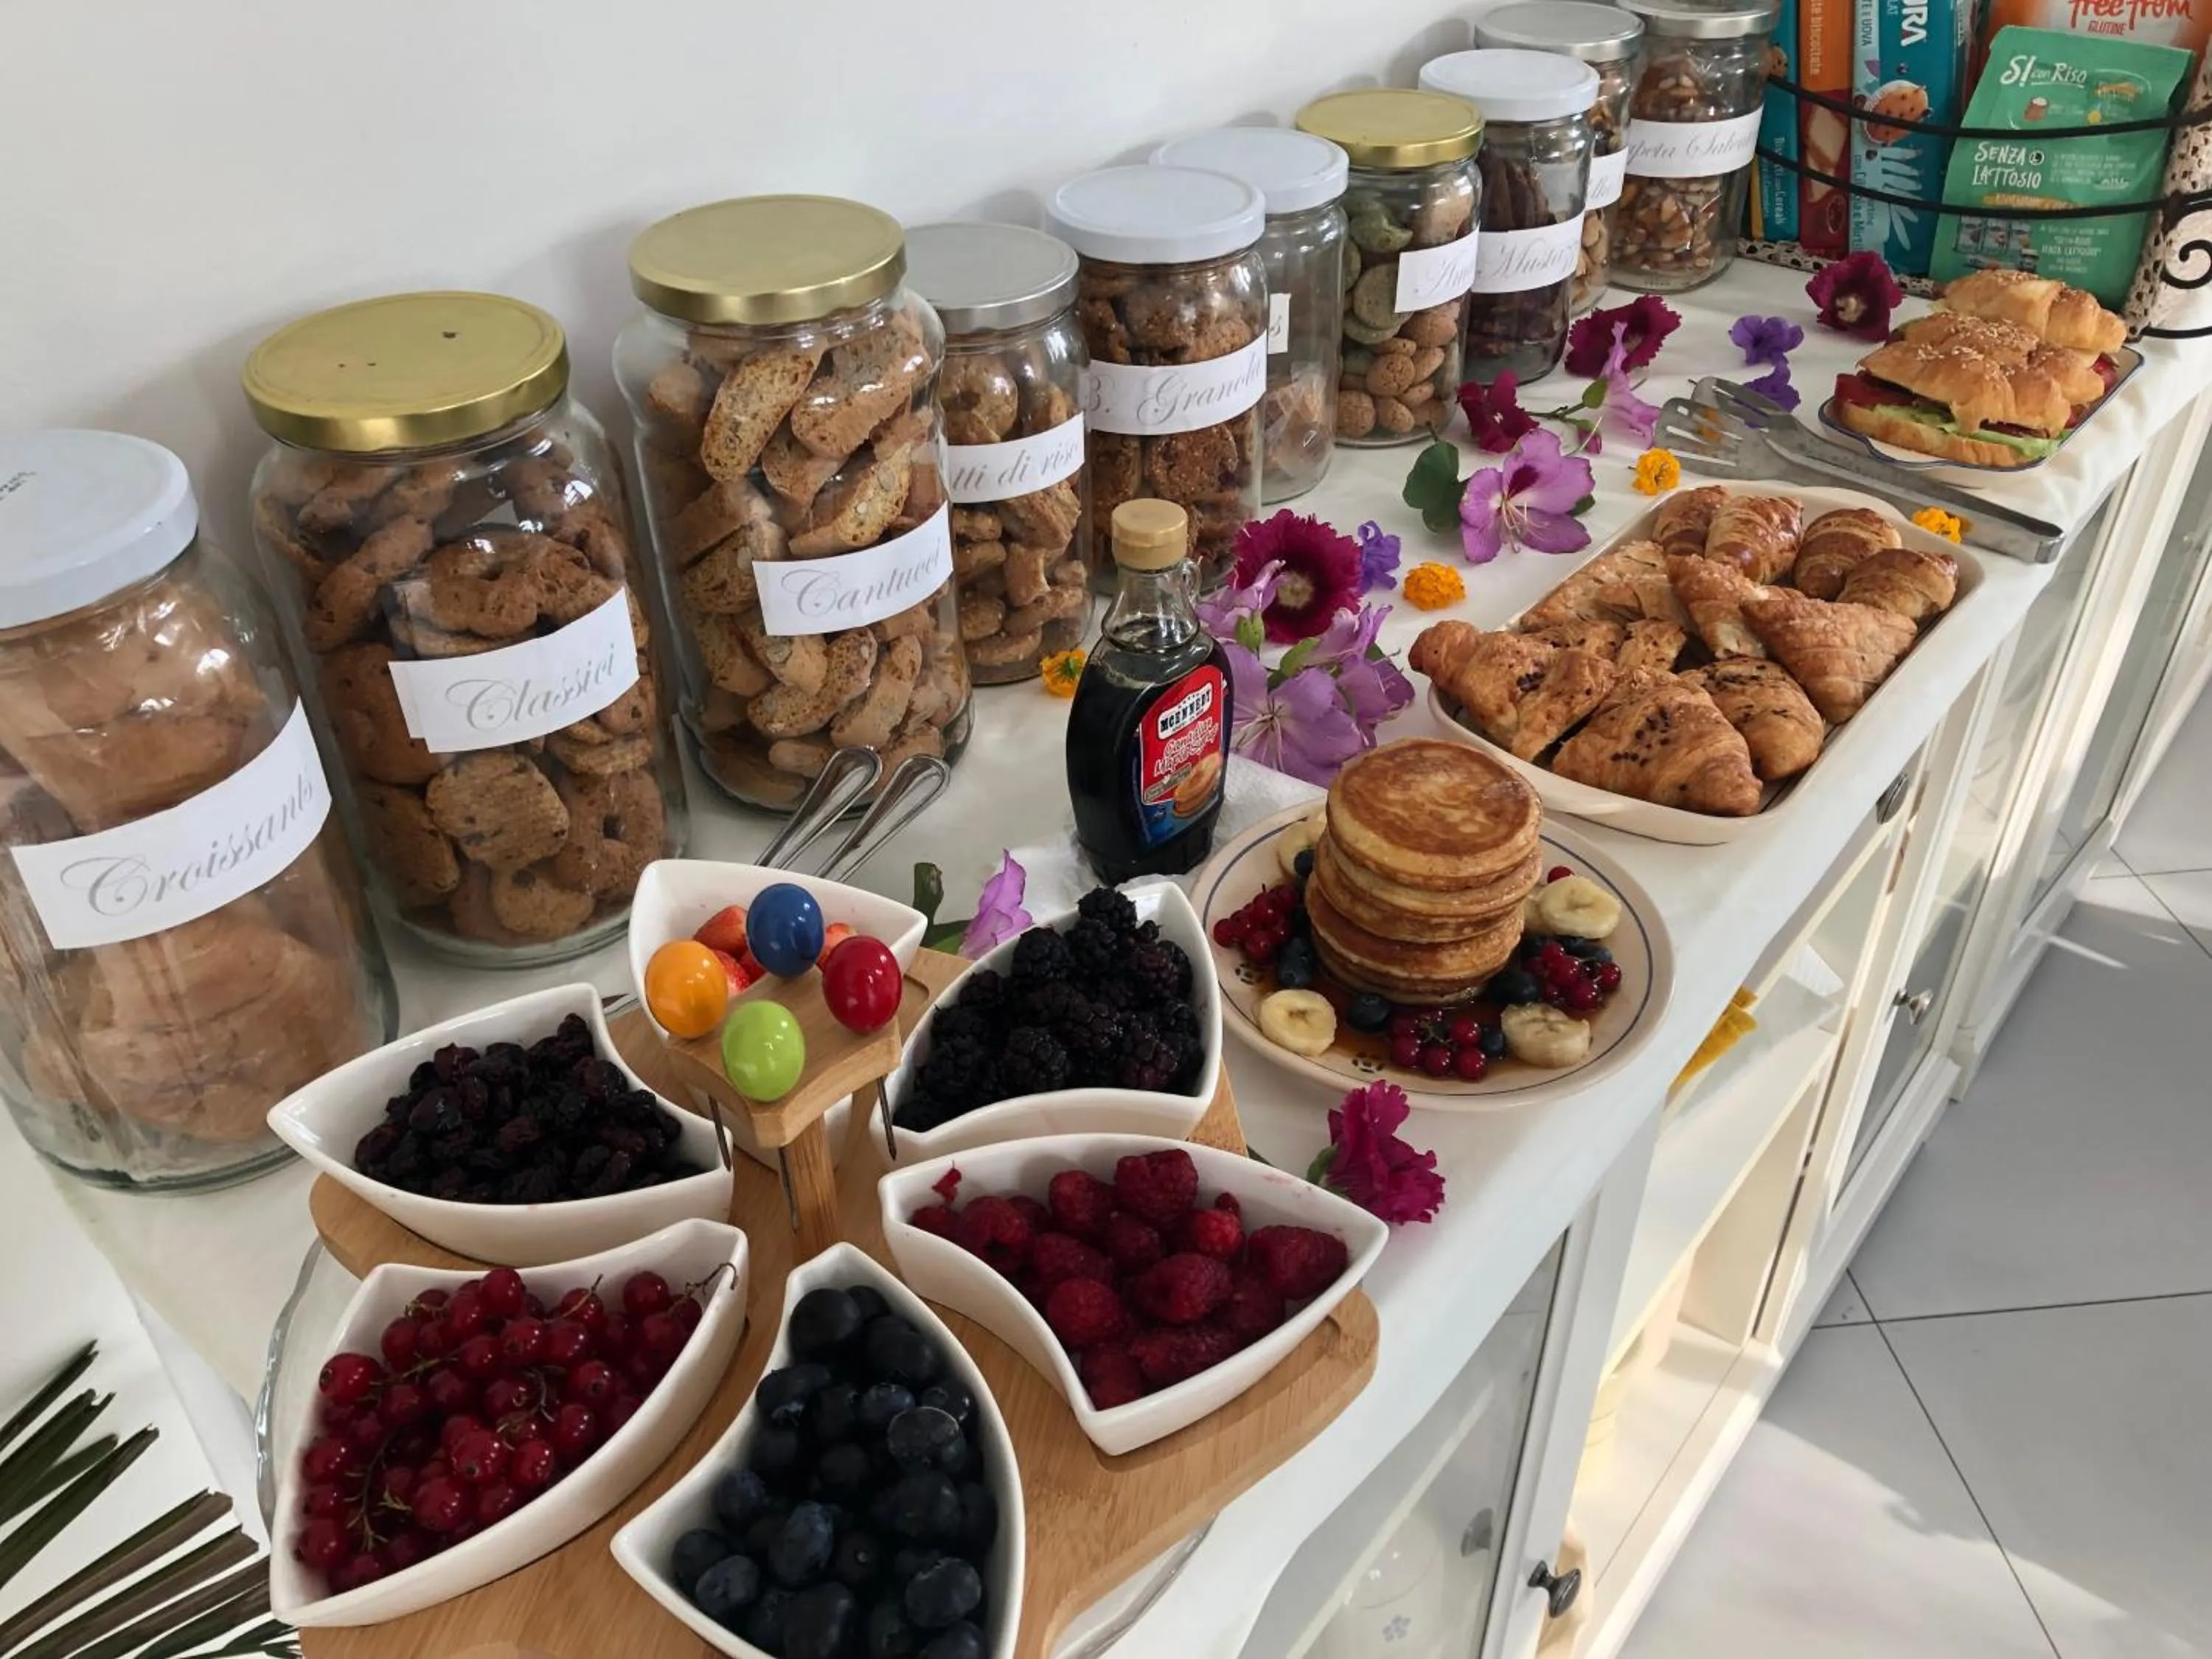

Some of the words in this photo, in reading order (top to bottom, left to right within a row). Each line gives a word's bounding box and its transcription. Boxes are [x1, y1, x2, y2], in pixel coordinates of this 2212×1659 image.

[1861, 18, 1872, 46] UOVA
[2087, 20, 2127, 35] GLUTINE
[2051, 63, 2088, 83] Riso
[1974, 142, 2026, 167] SENZA
[1972, 165, 2043, 189] LATTOSIO
[997, 449, 1032, 486] di
[445, 642, 616, 732] Classici
